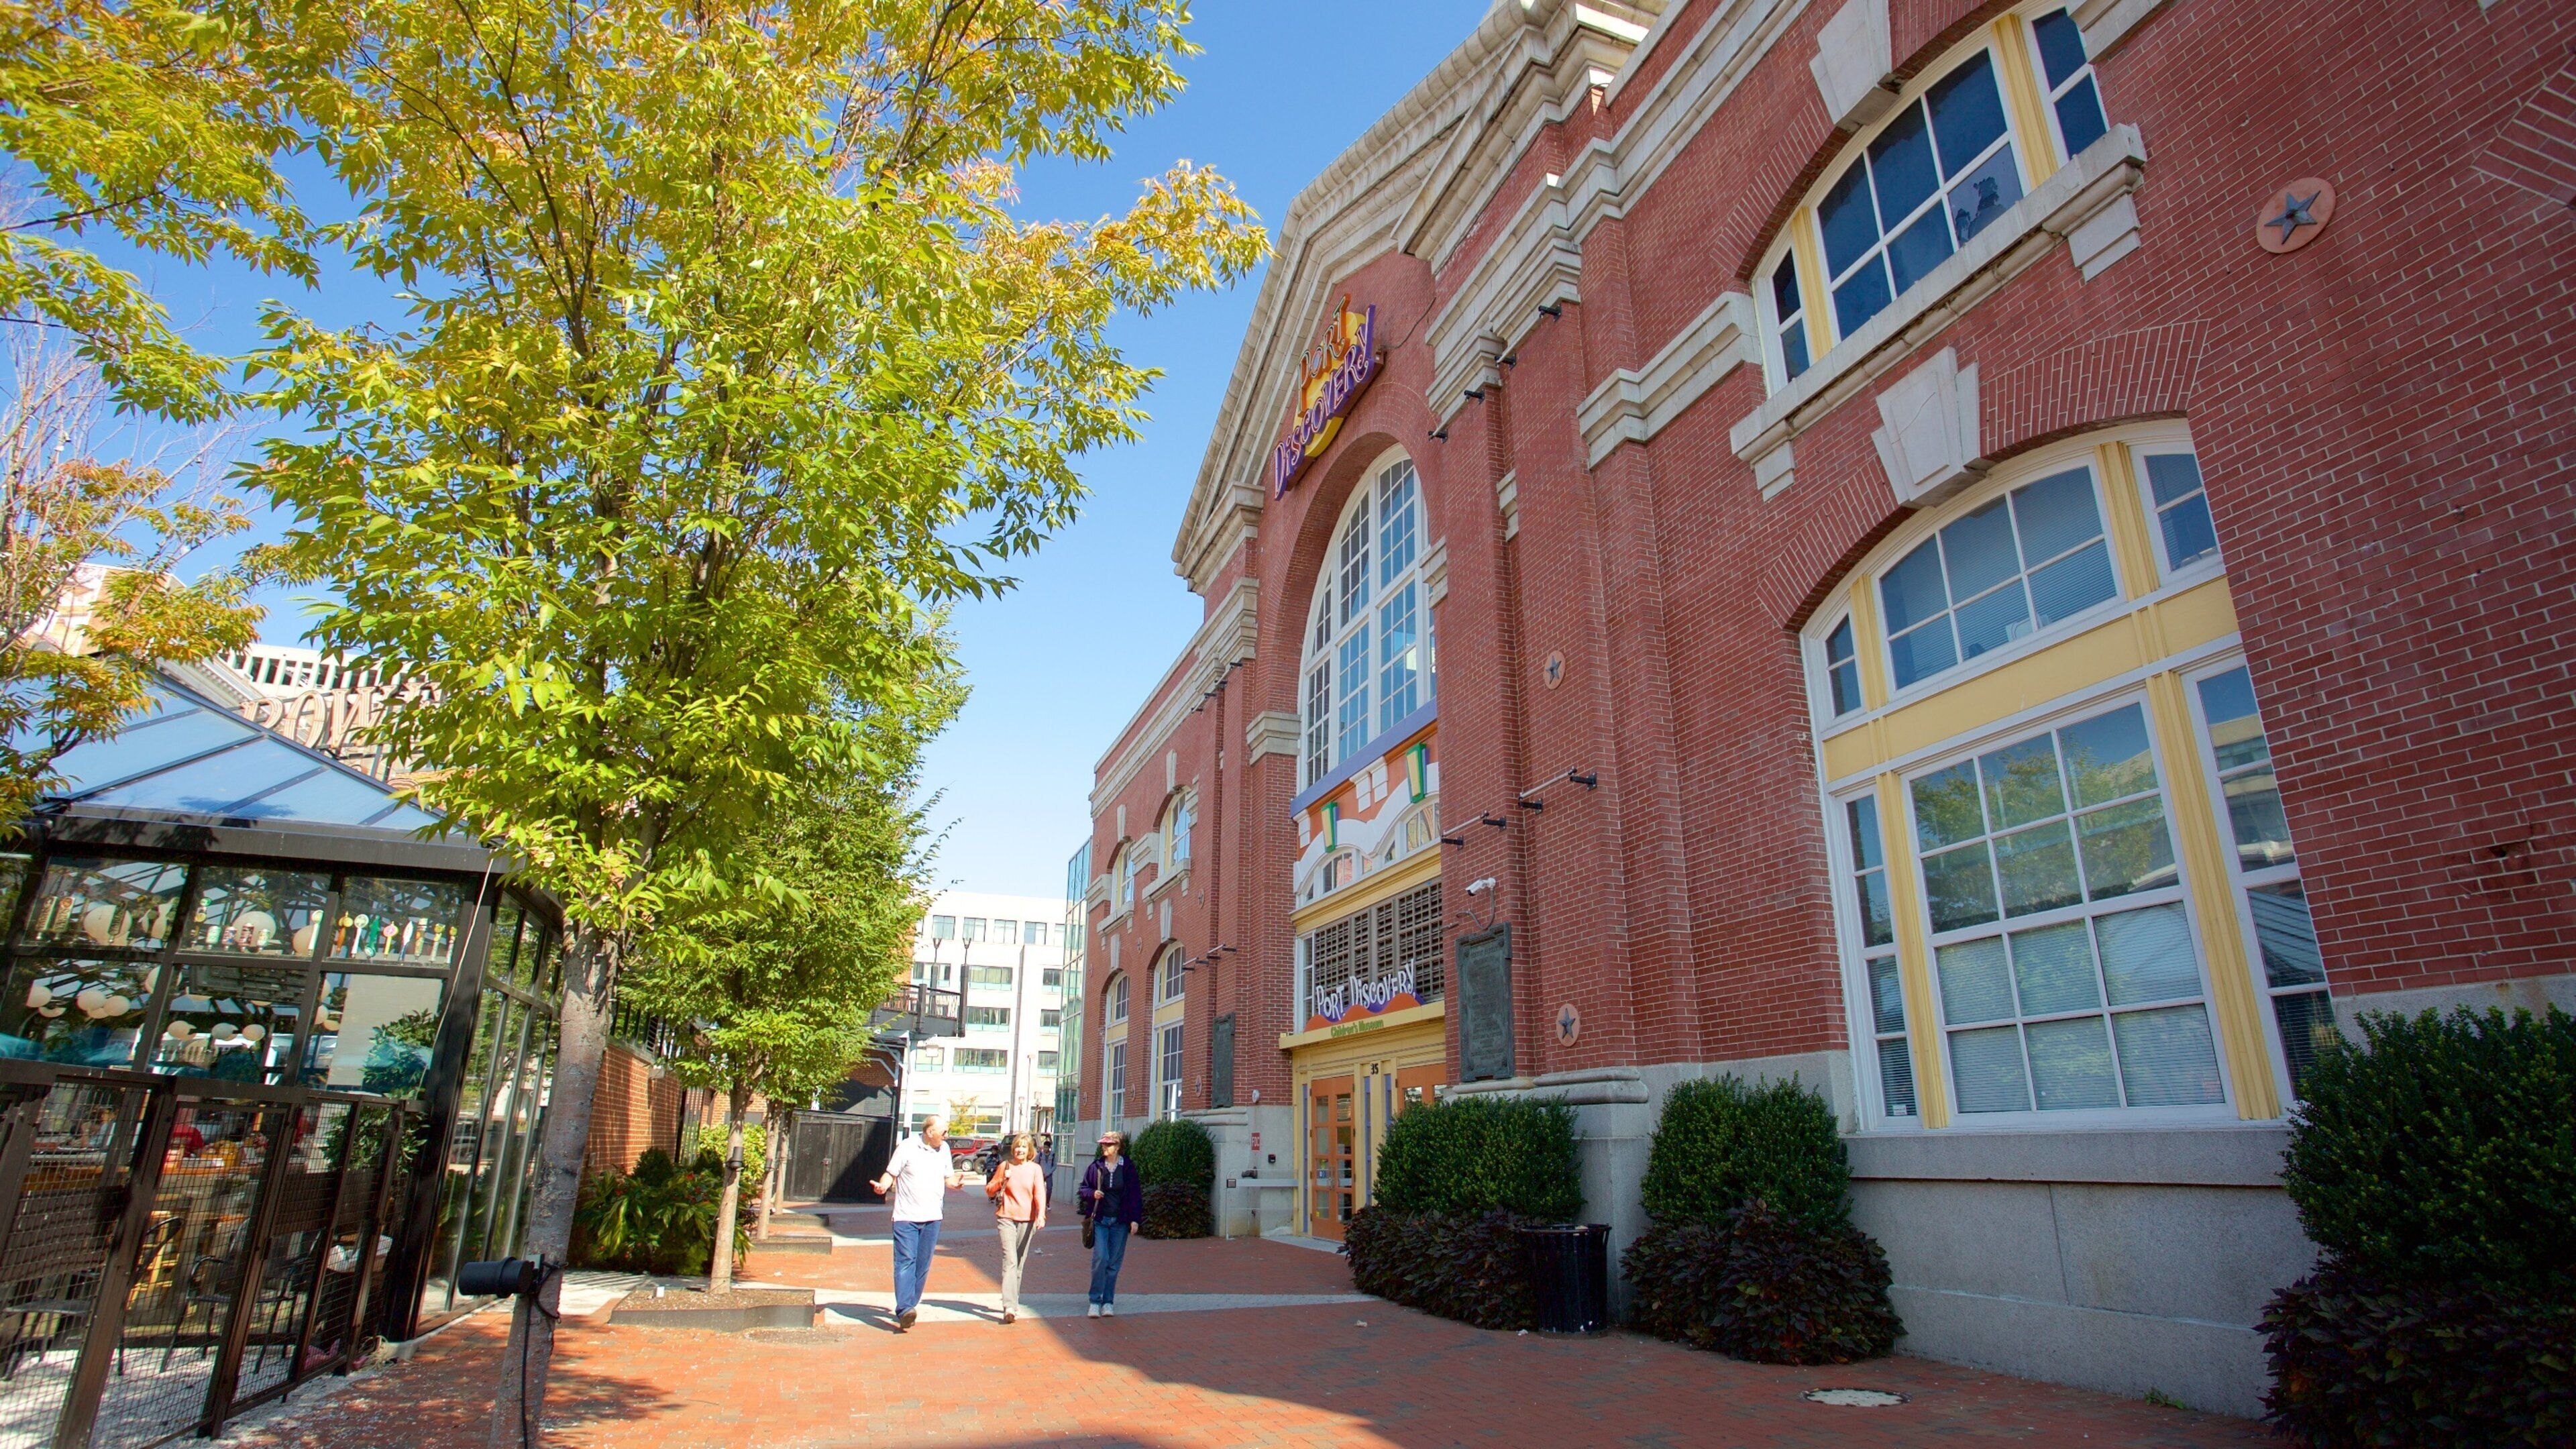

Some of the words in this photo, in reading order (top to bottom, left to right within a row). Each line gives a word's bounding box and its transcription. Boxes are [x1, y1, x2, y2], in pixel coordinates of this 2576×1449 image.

[1297, 292, 1351, 417] PORT
[1316, 985, 1346, 1020] PORT
[1330, 1023, 1358, 1038] Children's
[1358, 1019, 1385, 1032] Museum
[1371, 1063, 1379, 1075] 35
